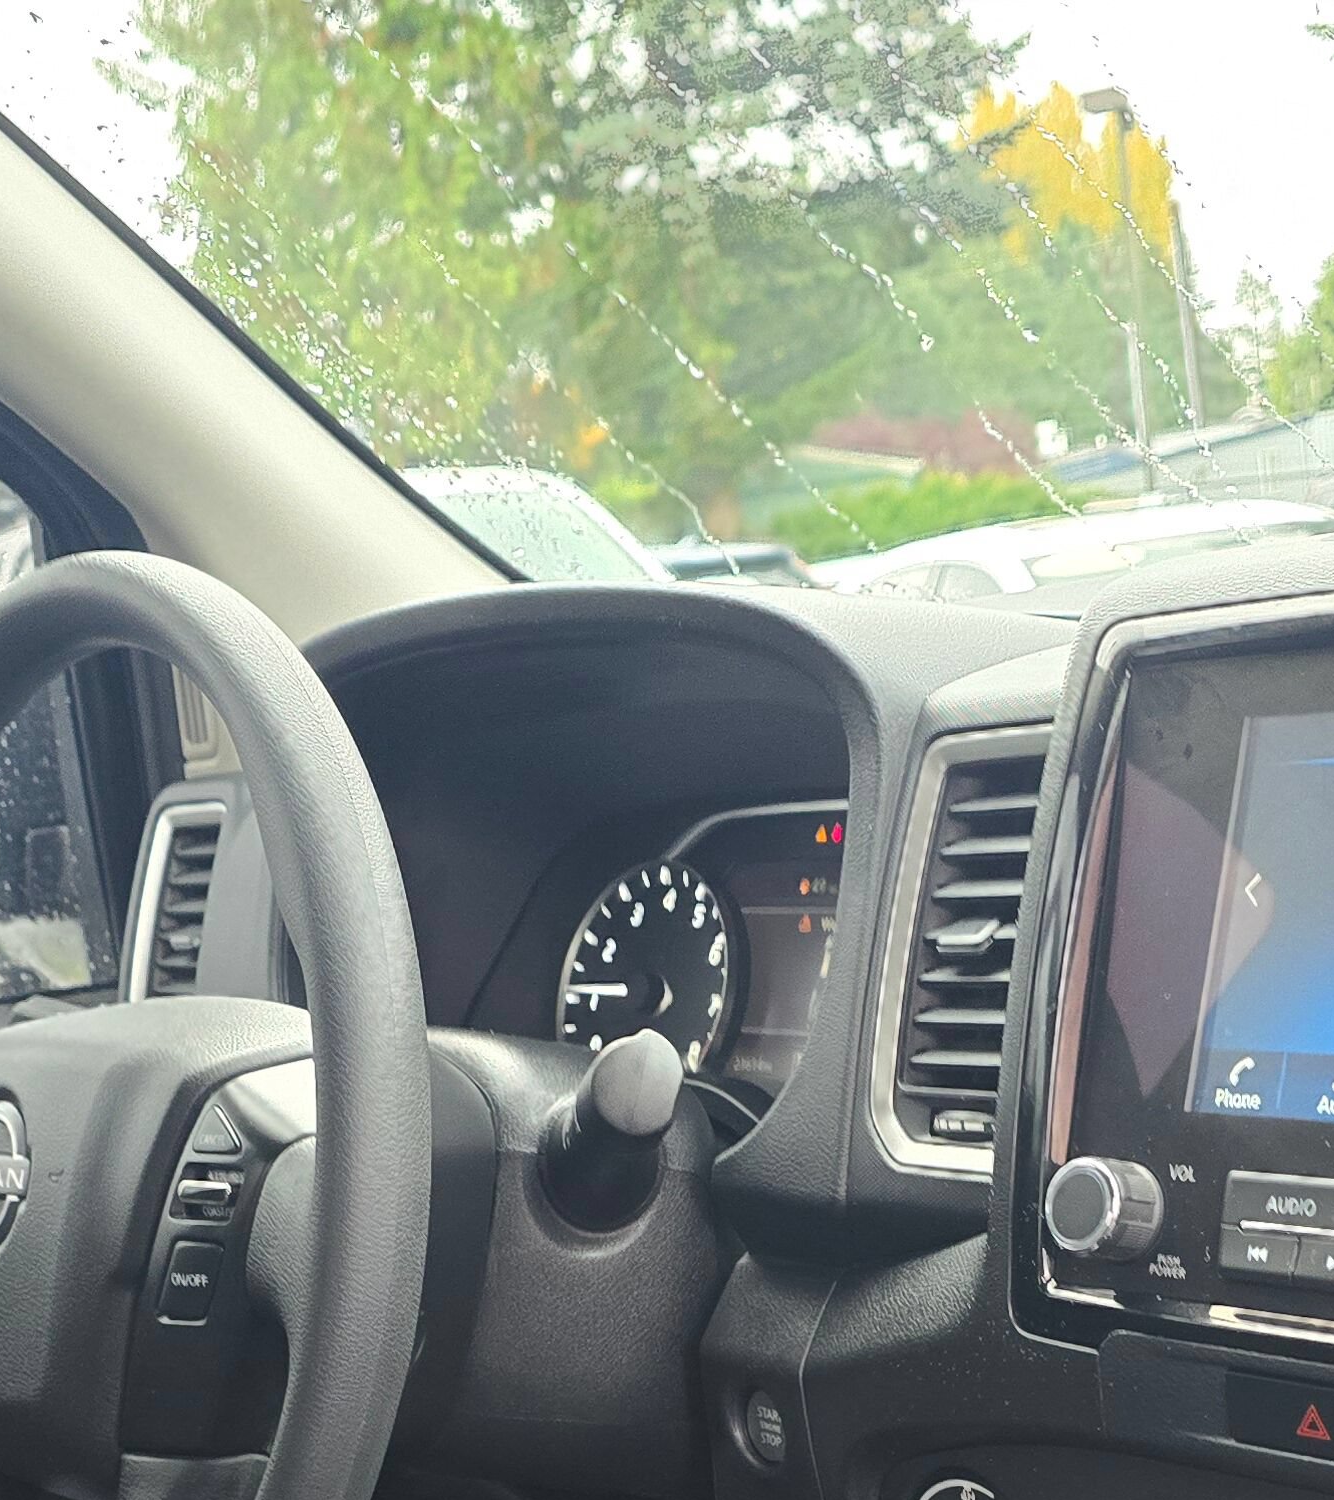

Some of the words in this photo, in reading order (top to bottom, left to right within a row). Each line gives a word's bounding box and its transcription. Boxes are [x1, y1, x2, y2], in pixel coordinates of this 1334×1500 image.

[1215, 1088, 1261, 1111] Phone
[1169, 1162, 1196, 1184] VOL
[1266, 1195, 1317, 1218] AUDIO
[170, 1271, 210, 1289] ON/OFF
